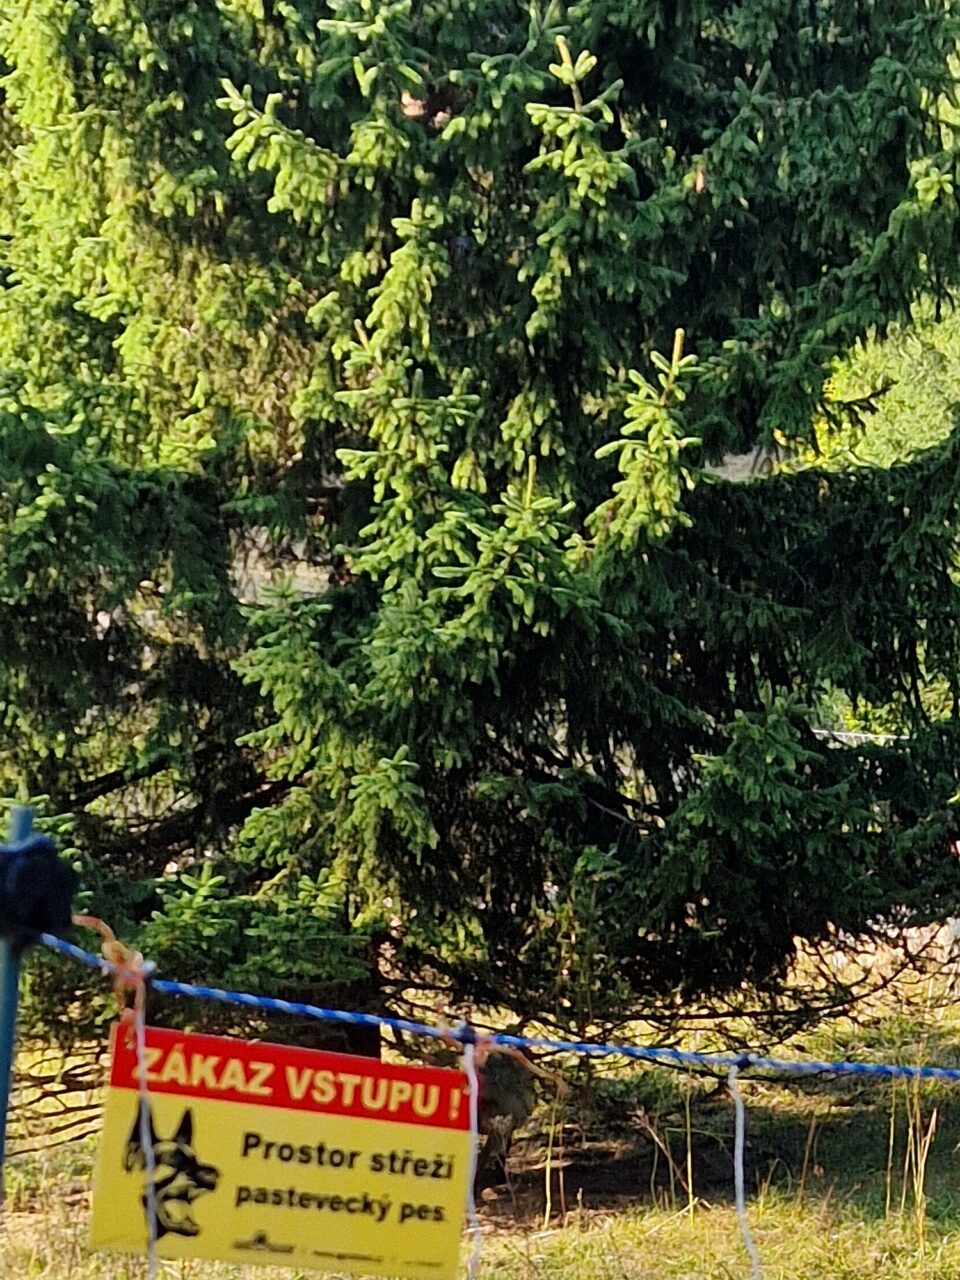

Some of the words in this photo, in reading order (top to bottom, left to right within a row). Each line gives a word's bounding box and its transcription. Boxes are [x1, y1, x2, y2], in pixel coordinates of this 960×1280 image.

[132, 1042, 276, 1097] ZÁKAZ
[285, 1065, 440, 1117] VSTUPU
[241, 1131, 361, 1170] Prostor
[370, 1149, 455, 1180] střeží
[235, 1183, 392, 1223] pastevecký
[399, 1201, 446, 1224] pes
